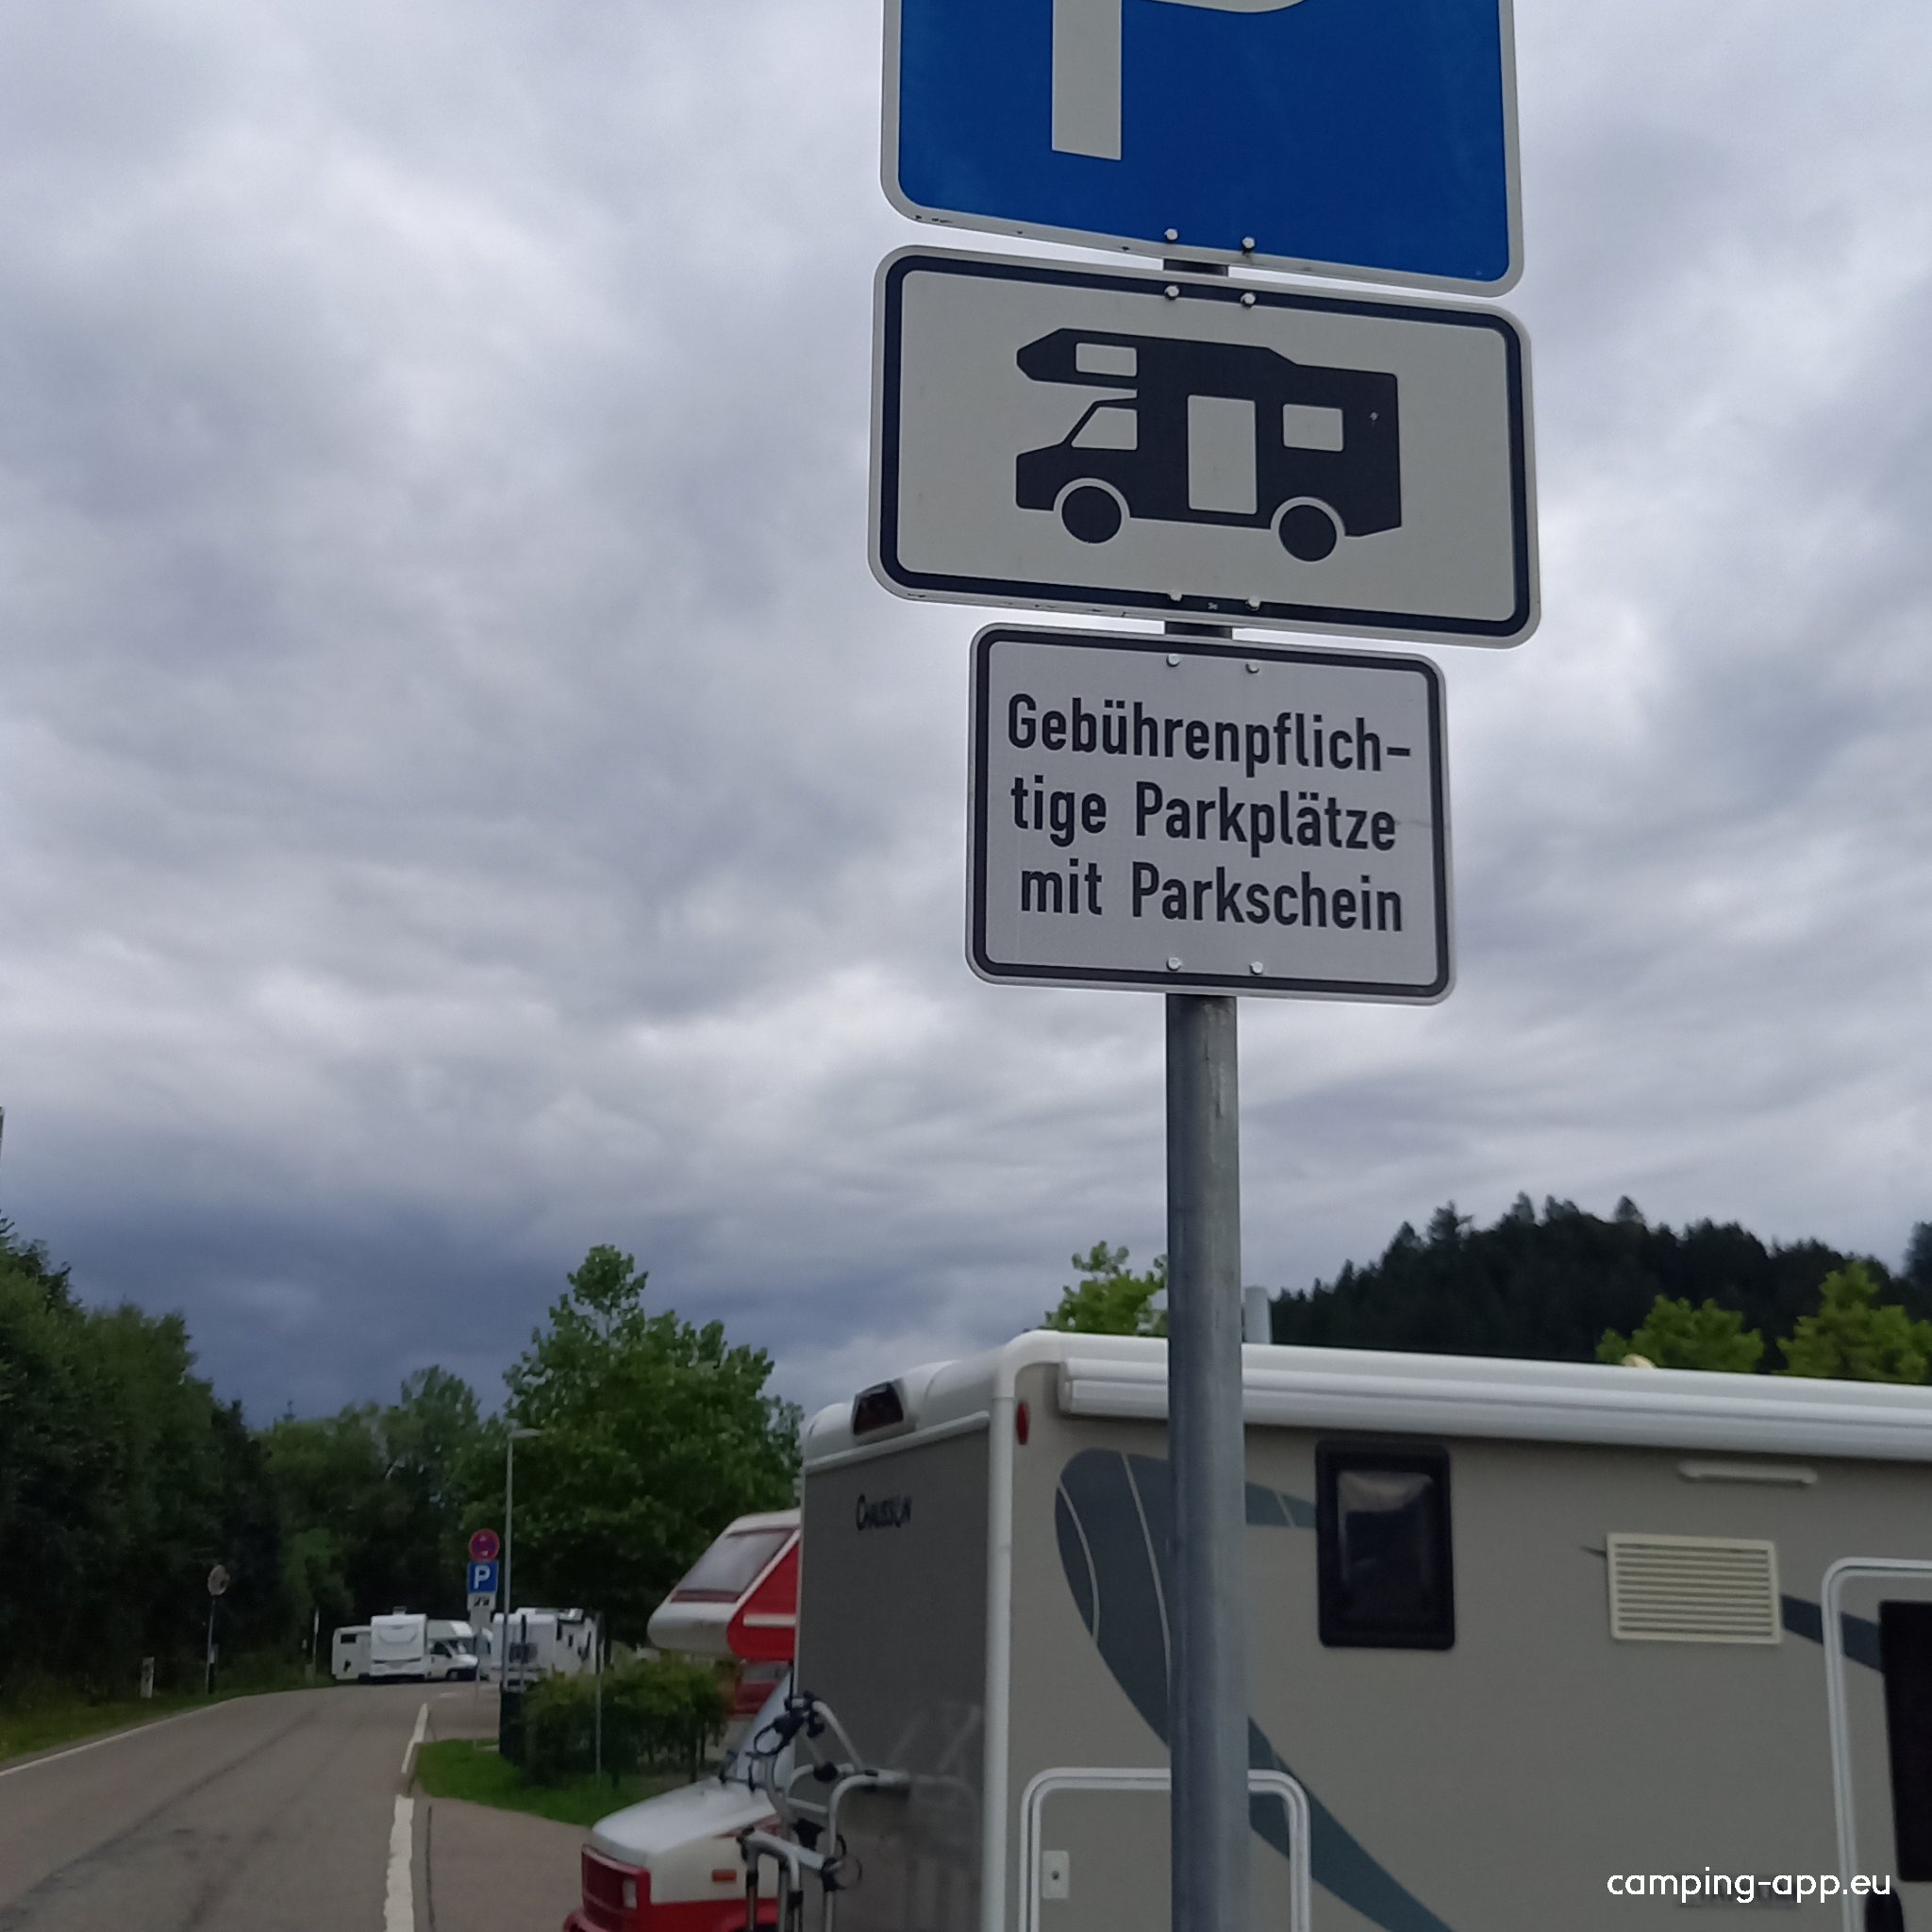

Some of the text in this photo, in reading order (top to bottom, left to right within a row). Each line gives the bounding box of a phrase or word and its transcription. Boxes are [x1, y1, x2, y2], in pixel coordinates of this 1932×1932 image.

[1008, 693, 1411, 777] Gebührenpflich-
[1010, 774, 1397, 858] tige Parkplätze
[1021, 858, 1403, 932] mit Parkschein
[474, 1565, 491, 1590] P
